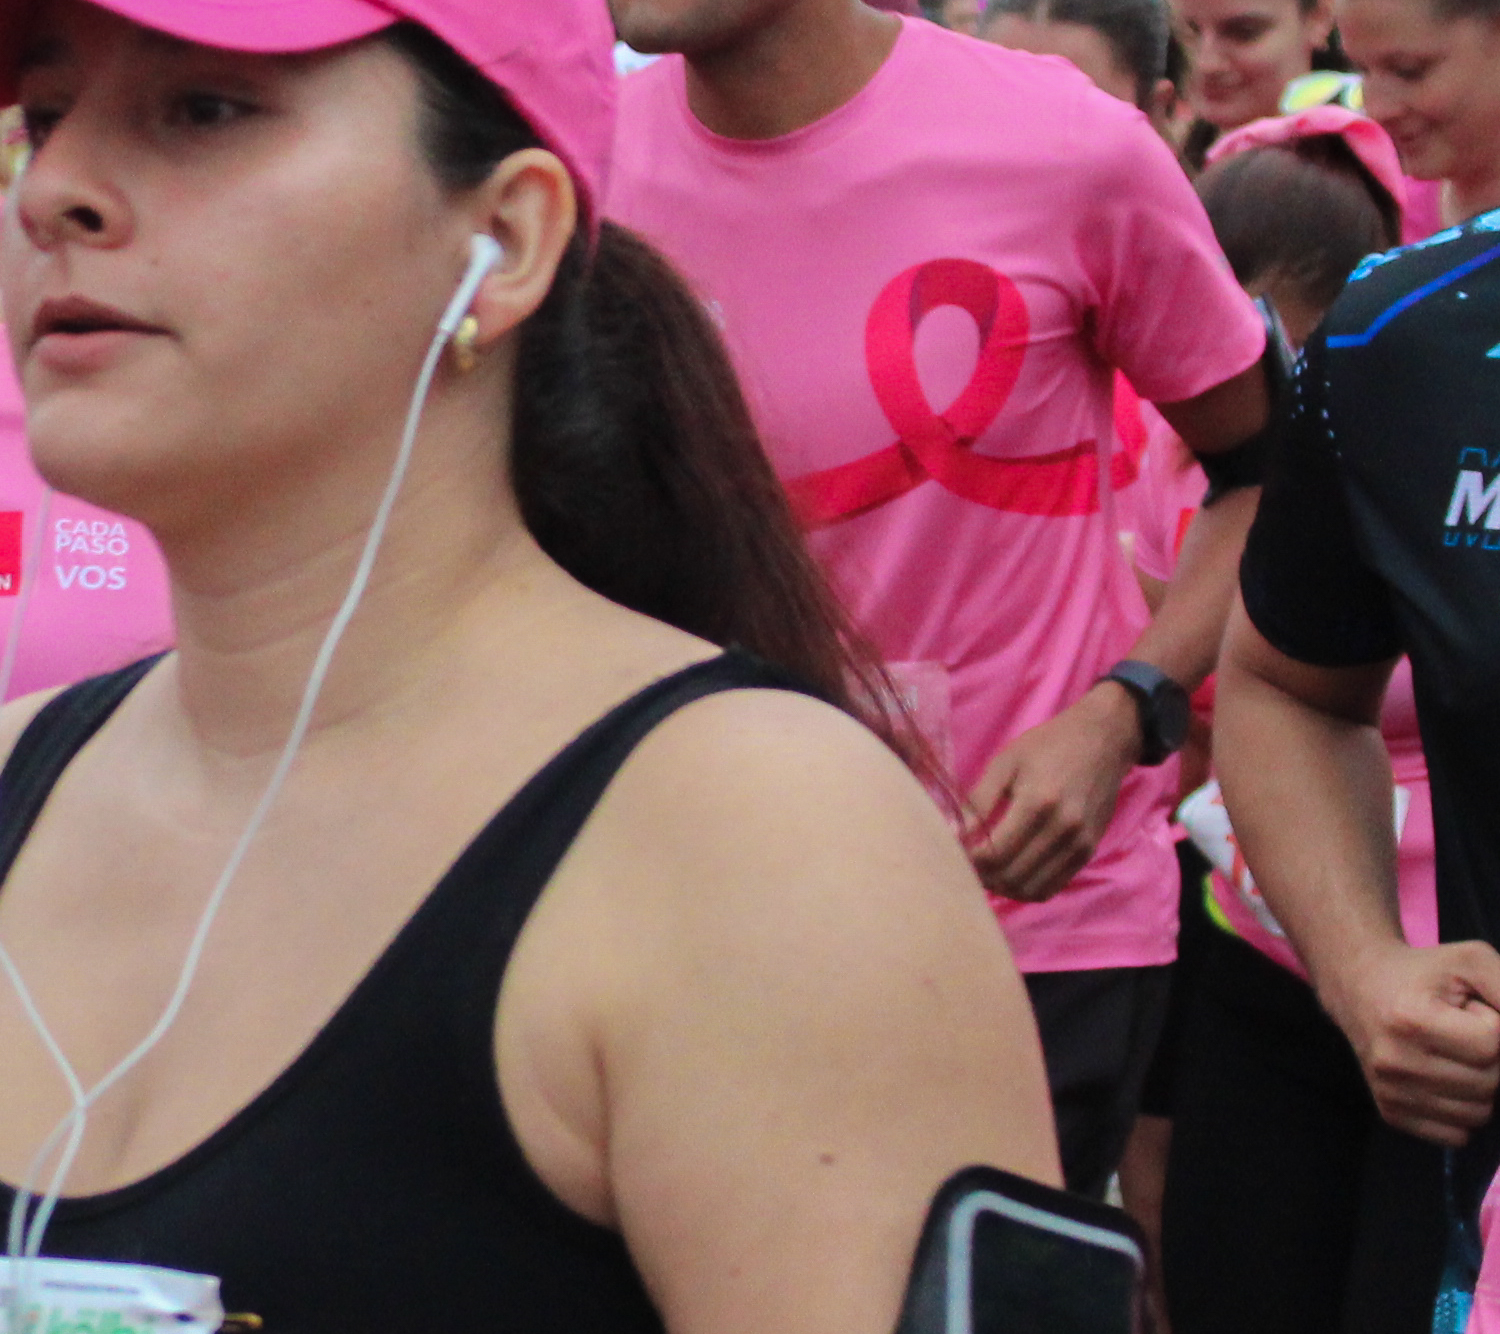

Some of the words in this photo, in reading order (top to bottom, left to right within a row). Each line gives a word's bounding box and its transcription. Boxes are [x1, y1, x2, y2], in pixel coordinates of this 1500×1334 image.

[56, 519, 127, 537] CADA
[55, 531, 129, 555] PASO
[55, 565, 127, 590] VOS
